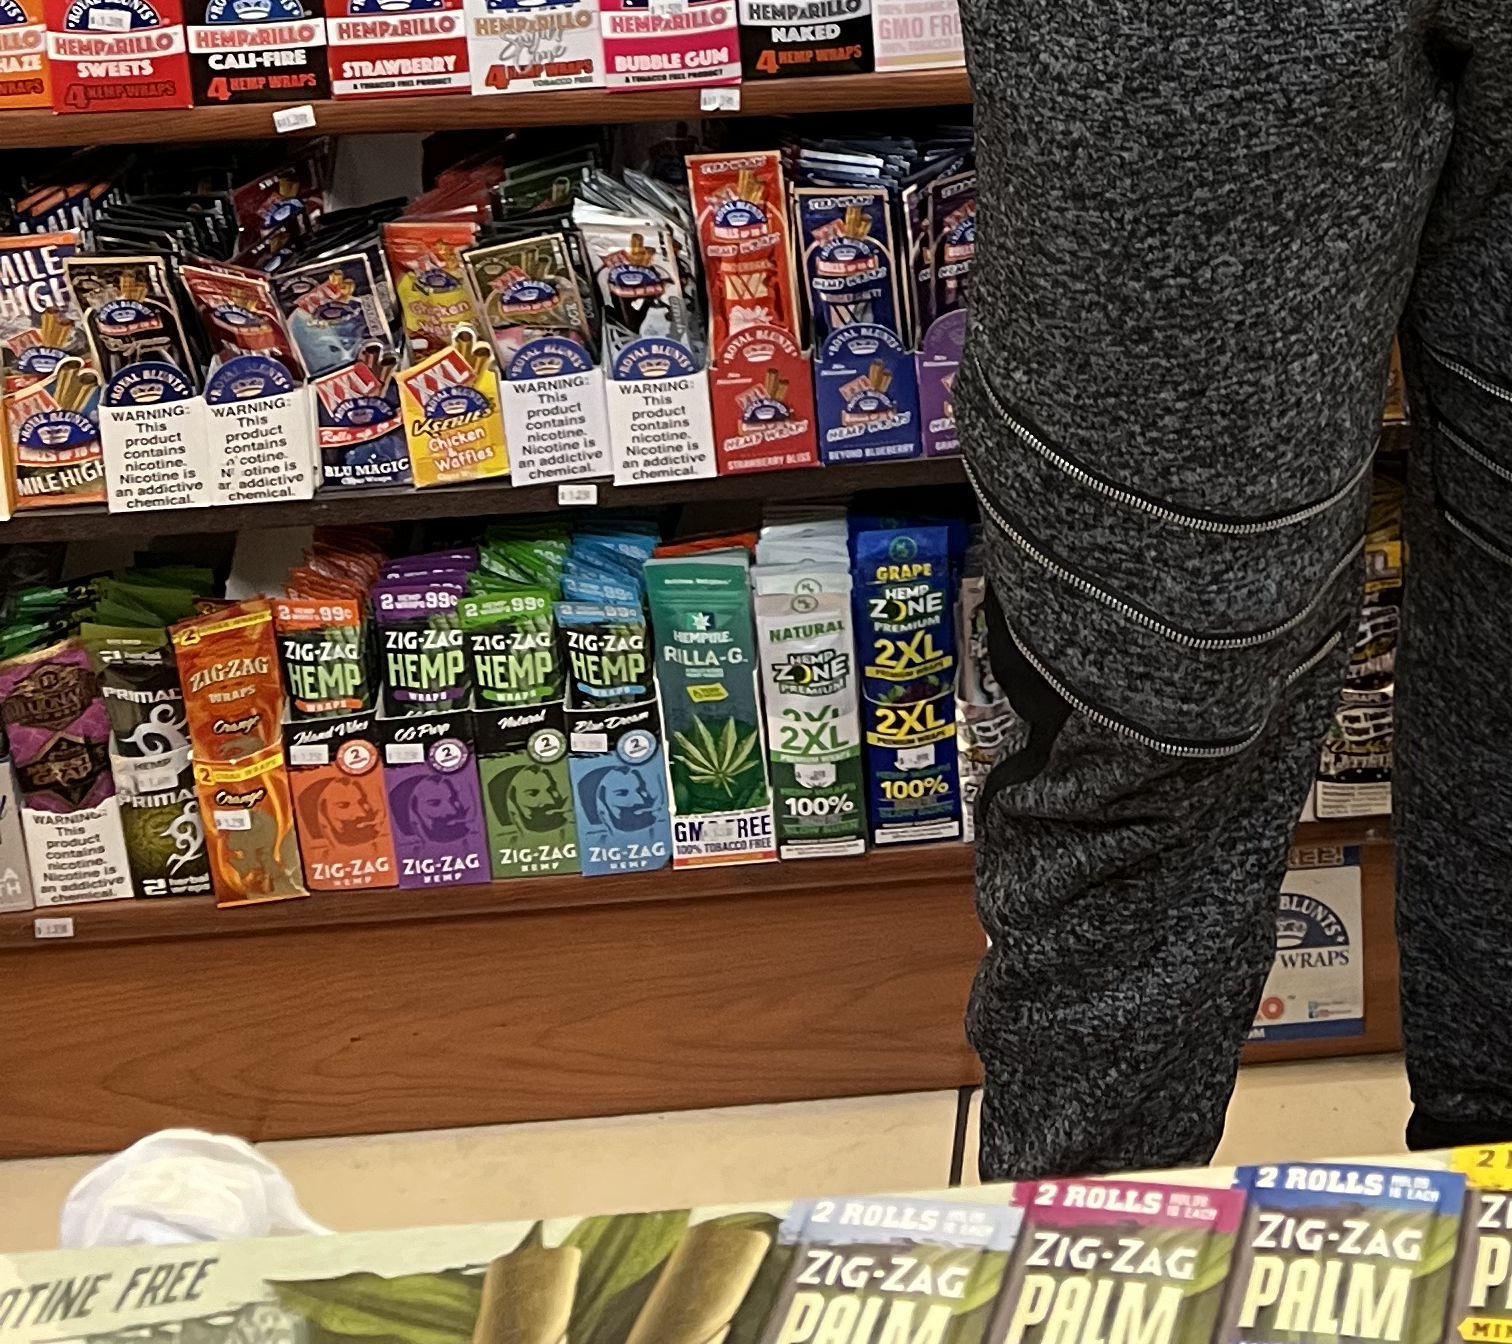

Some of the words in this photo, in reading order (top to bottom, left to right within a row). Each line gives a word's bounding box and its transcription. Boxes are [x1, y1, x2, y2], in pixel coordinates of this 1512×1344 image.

[771, 24, 841, 42] NAKED
[342, 55, 457, 77] STRAWBERRY
[615, 54, 681, 73] BUBBLE
[684, 48, 729, 68] GUM
[110, 406, 191, 423] WARNING:
[135, 422, 167, 433] This
[125, 433, 182, 449] product
[124, 445, 186, 460] contains
[324, 463, 354, 477] BLU
[359, 457, 409, 475] MAGIC
[120, 471, 179, 485] Nicotine
[183, 469, 196, 479] is
[116, 488, 133, 497] an
[137, 481, 203, 496] addictive
[876, 564, 933, 582] GRAPE
[769, 619, 846, 644] NATURAL
[284, 640, 358, 660] ZIG-ZAG
[287, 660, 362, 699] HEMP
[1280, 949, 1350, 969] WRAPS
[114, 1257, 220, 1310] FREE
